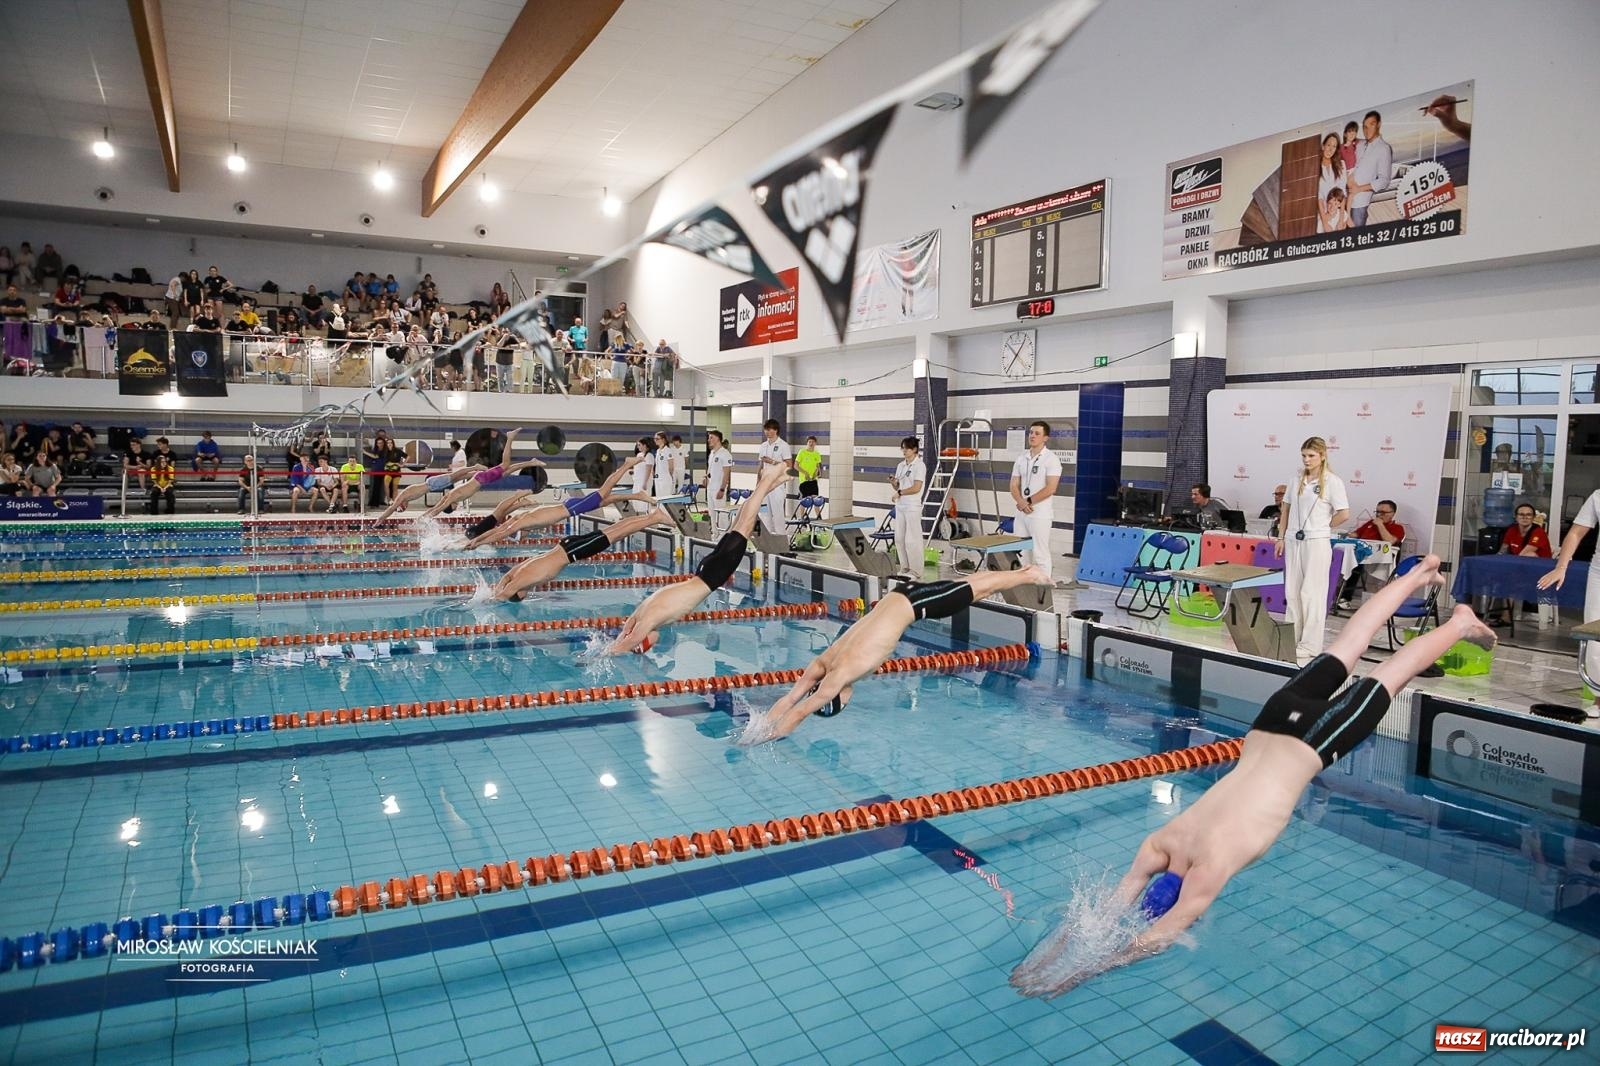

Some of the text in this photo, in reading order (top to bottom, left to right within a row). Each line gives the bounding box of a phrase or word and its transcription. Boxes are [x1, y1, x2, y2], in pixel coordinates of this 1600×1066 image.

[1404, 169, 1445, 196] -15%
[1200, 188, 1220, 200] DRZWI
[1408, 191, 1452, 217] MONTAŻEM
[1182, 208, 1211, 223] BRAMY
[1037, 231, 1045, 240] 5.
[1185, 225, 1210, 239] DRZWI
[1180, 241, 1209, 256] PANELE
[1218, 246, 1269, 267] RACIBÓRZ
[1273, 248, 1284, 259] ul.
[1287, 240, 1337, 256] Głubczycka
[1340, 236, 1355, 248] 13,
[1358, 233, 1374, 245] tel:
[1376, 229, 1390, 242] 32
[1399, 225, 1420, 238] 415
[1422, 222, 1437, 235] 25
[1440, 219, 1455, 232] 00
[975, 246, 982, 254] 1.
[1036, 248, 1044, 257] 6.
[975, 262, 982, 270] 2.
[1036, 265, 1044, 274] 7.
[1187, 257, 1209, 270] OKNA
[974, 278, 981, 286] 3.
[1035, 283, 1043, 292] 8.
[974, 294, 981, 302] 4.
[757, 295, 795, 318] informacji
[739, 308, 751, 322] rtk
[6, 500, 42, 510] Śląskie.
[622, 500, 630, 512] 2
[679, 509, 686, 523] 3
[855, 536, 865, 556] 5
[1251, 597, 1262, 628] 7
[1483, 752, 1545, 774] TIME SYSTEMS
